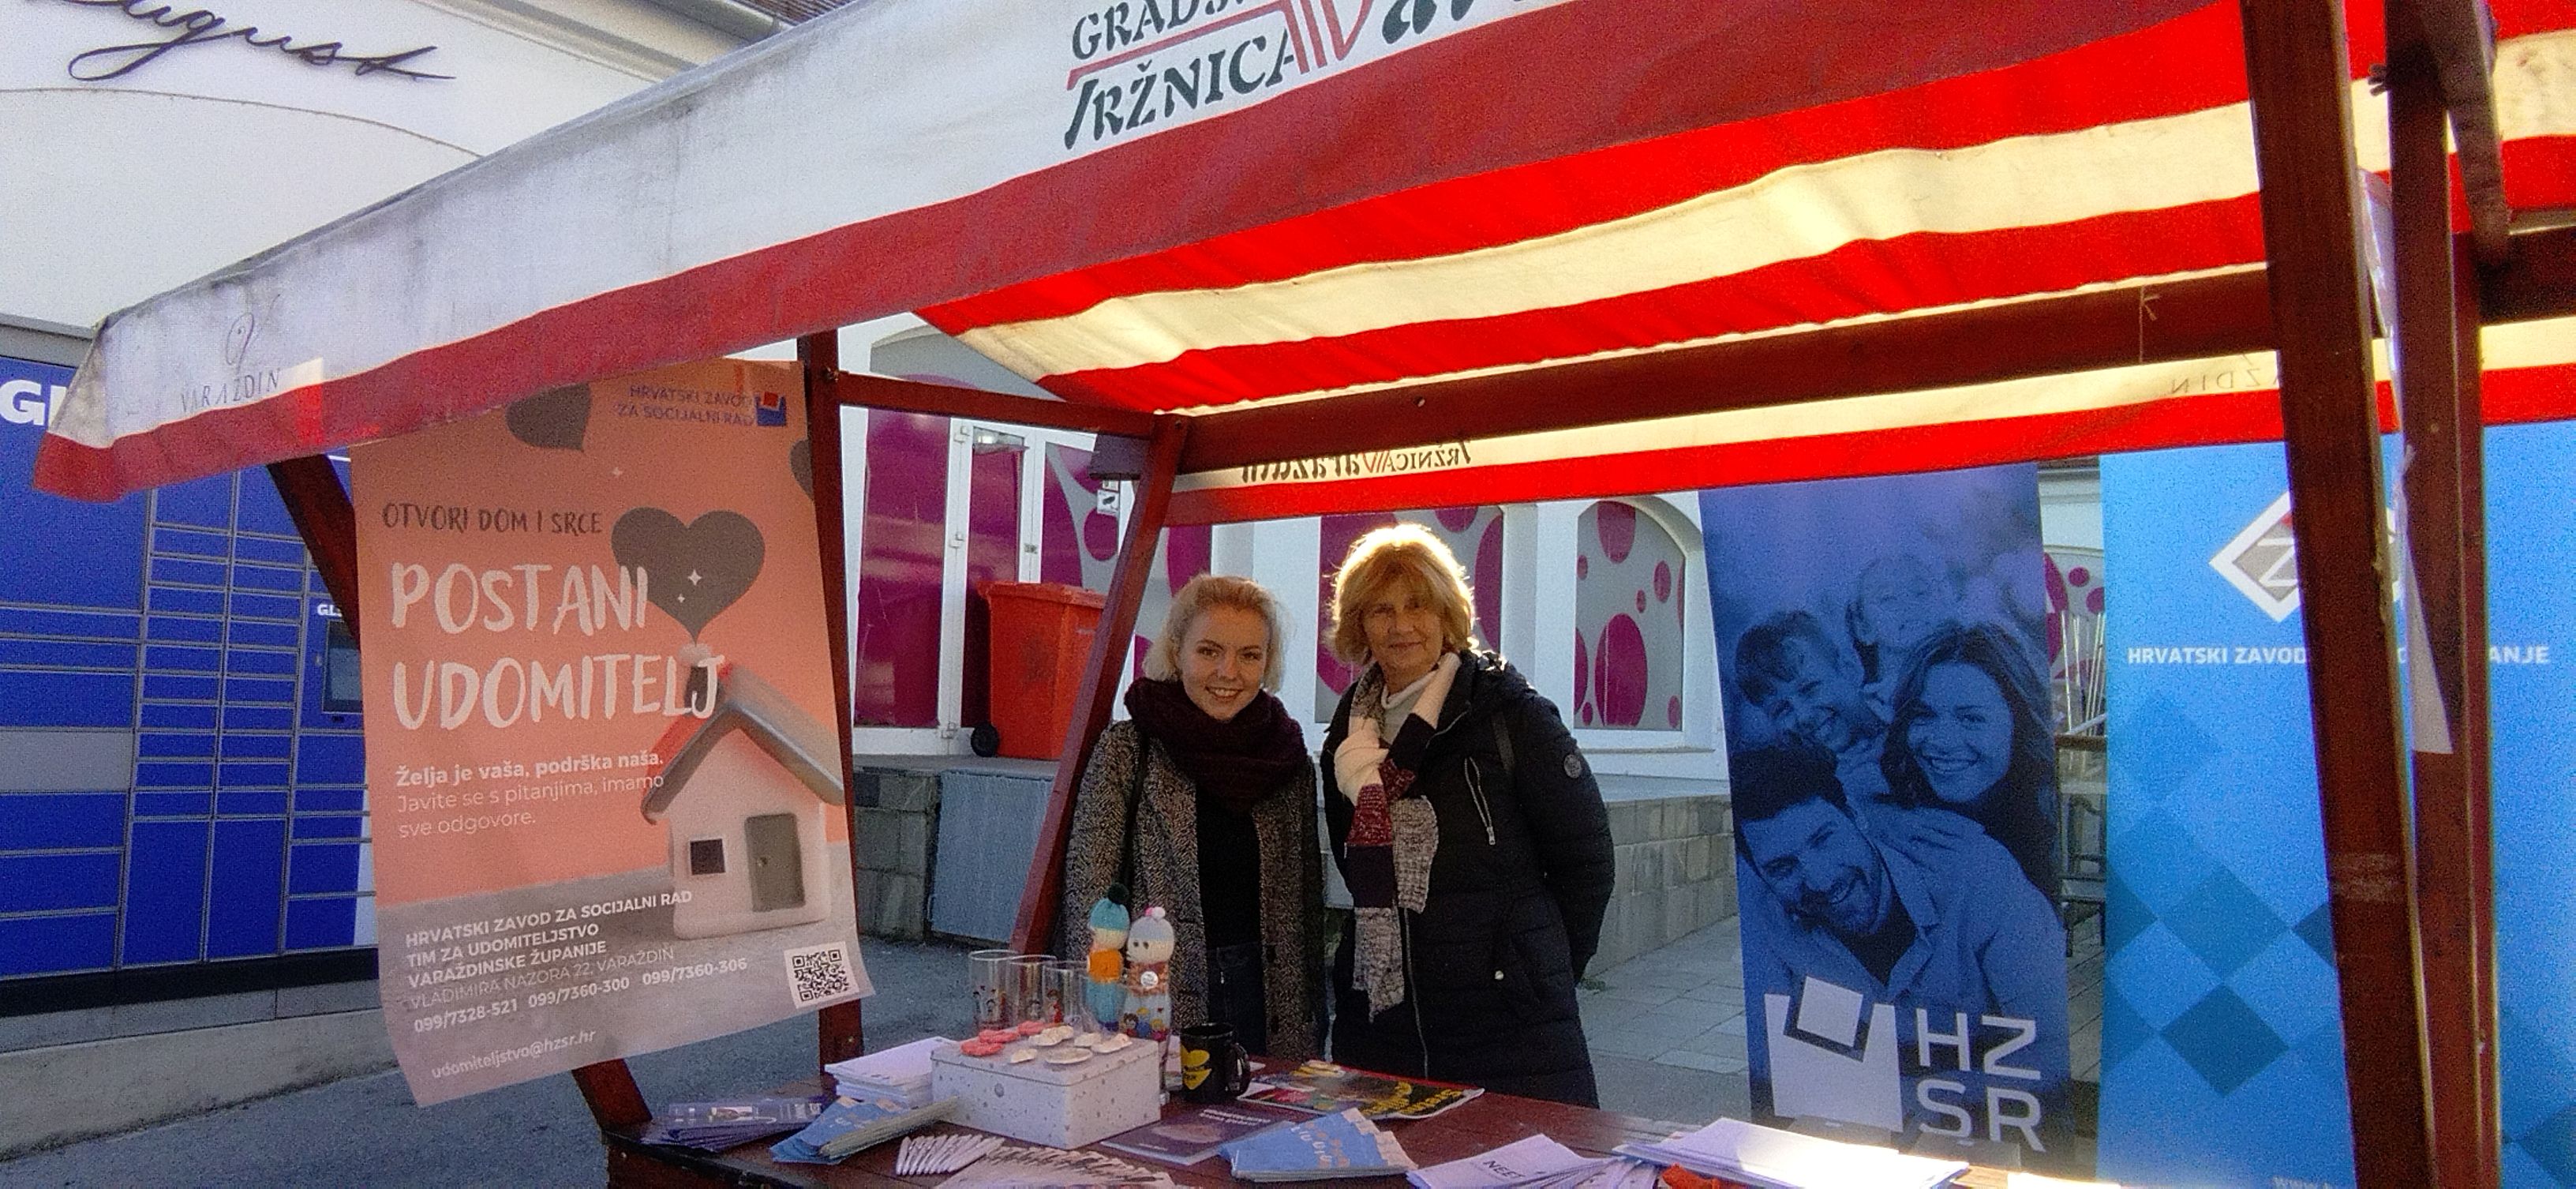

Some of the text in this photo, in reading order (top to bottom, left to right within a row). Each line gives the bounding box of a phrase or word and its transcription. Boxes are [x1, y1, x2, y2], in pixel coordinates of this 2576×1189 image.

[617, 403, 638, 417] ZA
[643, 407, 719, 424] SOCIJALNI
[631, 385, 698, 403] HRVATSKI
[382, 502, 603, 537] OTVORI DOM I SRCE
[391, 563, 648, 636] POSTANI
[2128, 646, 2308, 665] HRVATSKI ZAVOD
[394, 653, 724, 730] UDOMITELJ
[395, 765, 447, 788] Želja
[454, 763, 472, 786] je
[535, 754, 612, 778] podrška
[618, 750, 664, 768] naša.
[398, 775, 665, 813] Javite se s pitanjima, imamo
[399, 810, 537, 838] sve odgovore.
[406, 891, 693, 947] HRVATSKI ZAVOD ZA SOCIJALNI RAD
[407, 923, 599, 968] TIM ZA UDOMITELJSTVO
[409, 940, 607, 988] VARAŽDINSKE ŽUPANIJE
[411, 980, 500, 1009] VLADIMIRA
[505, 966, 571, 991] NAZORA
[596, 946, 674, 972] VARAŽDIN
[414, 998, 518, 1033] 099/7328-521
[528, 977, 630, 1010] 099/7360-300
[432, 1029, 597, 1078] udomiteljstvo@hzsr.hr
[1916, 1007, 2041, 1080] HZ
[1917, 1078, 2046, 1153] SR
